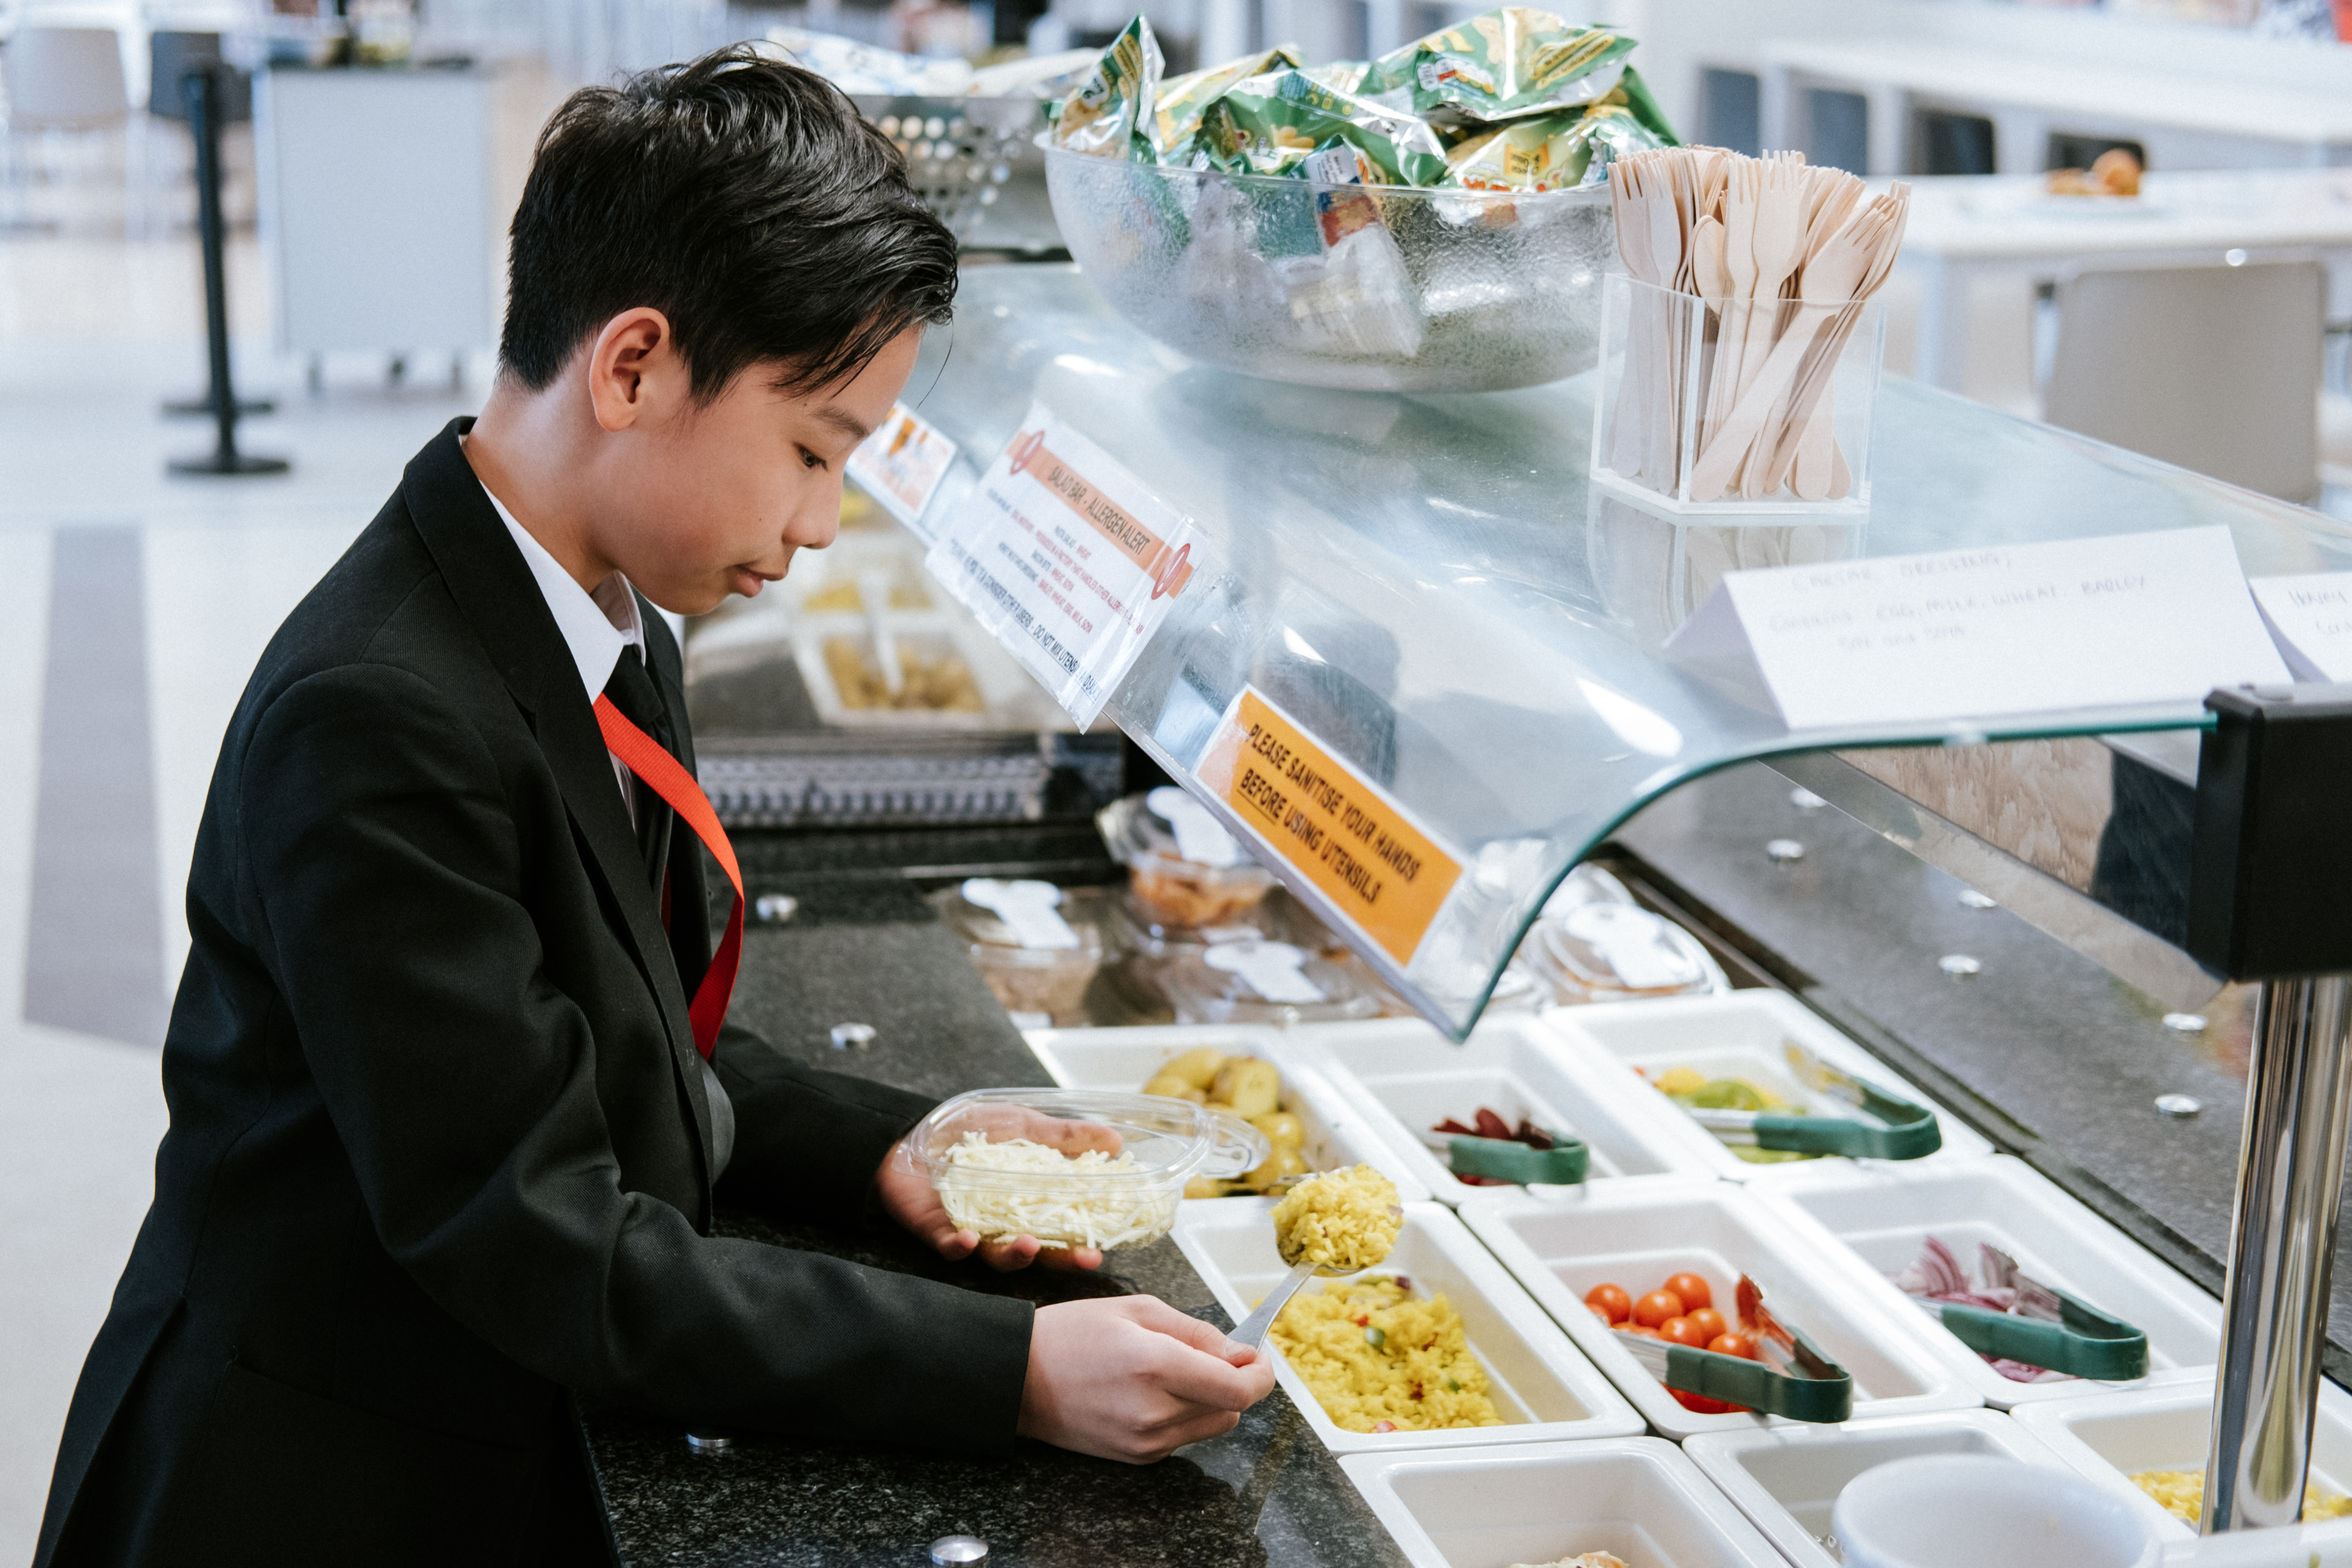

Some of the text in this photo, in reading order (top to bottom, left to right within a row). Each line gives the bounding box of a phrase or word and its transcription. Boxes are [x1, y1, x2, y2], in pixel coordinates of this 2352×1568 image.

[1047, 465, 1151, 557] SALAD BAR ALLERGEN ALERT
[1070, 562, 1083, 577] THAT
[1079, 570, 1098, 591] HANDLES
[1094, 584, 1110, 601] OTHER
[1015, 606, 1034, 629] USERS
[1032, 623, 1046, 640] DO
[1040, 630, 1055, 650] NOT
[1049, 640, 1064, 658] MIX
[1080, 618, 1094, 634] SOYA
[1239, 767, 1383, 905] BEFORE USING UTENSILS
[1245, 722, 1423, 884] PLEASE SANITISE YOUR HANDS
